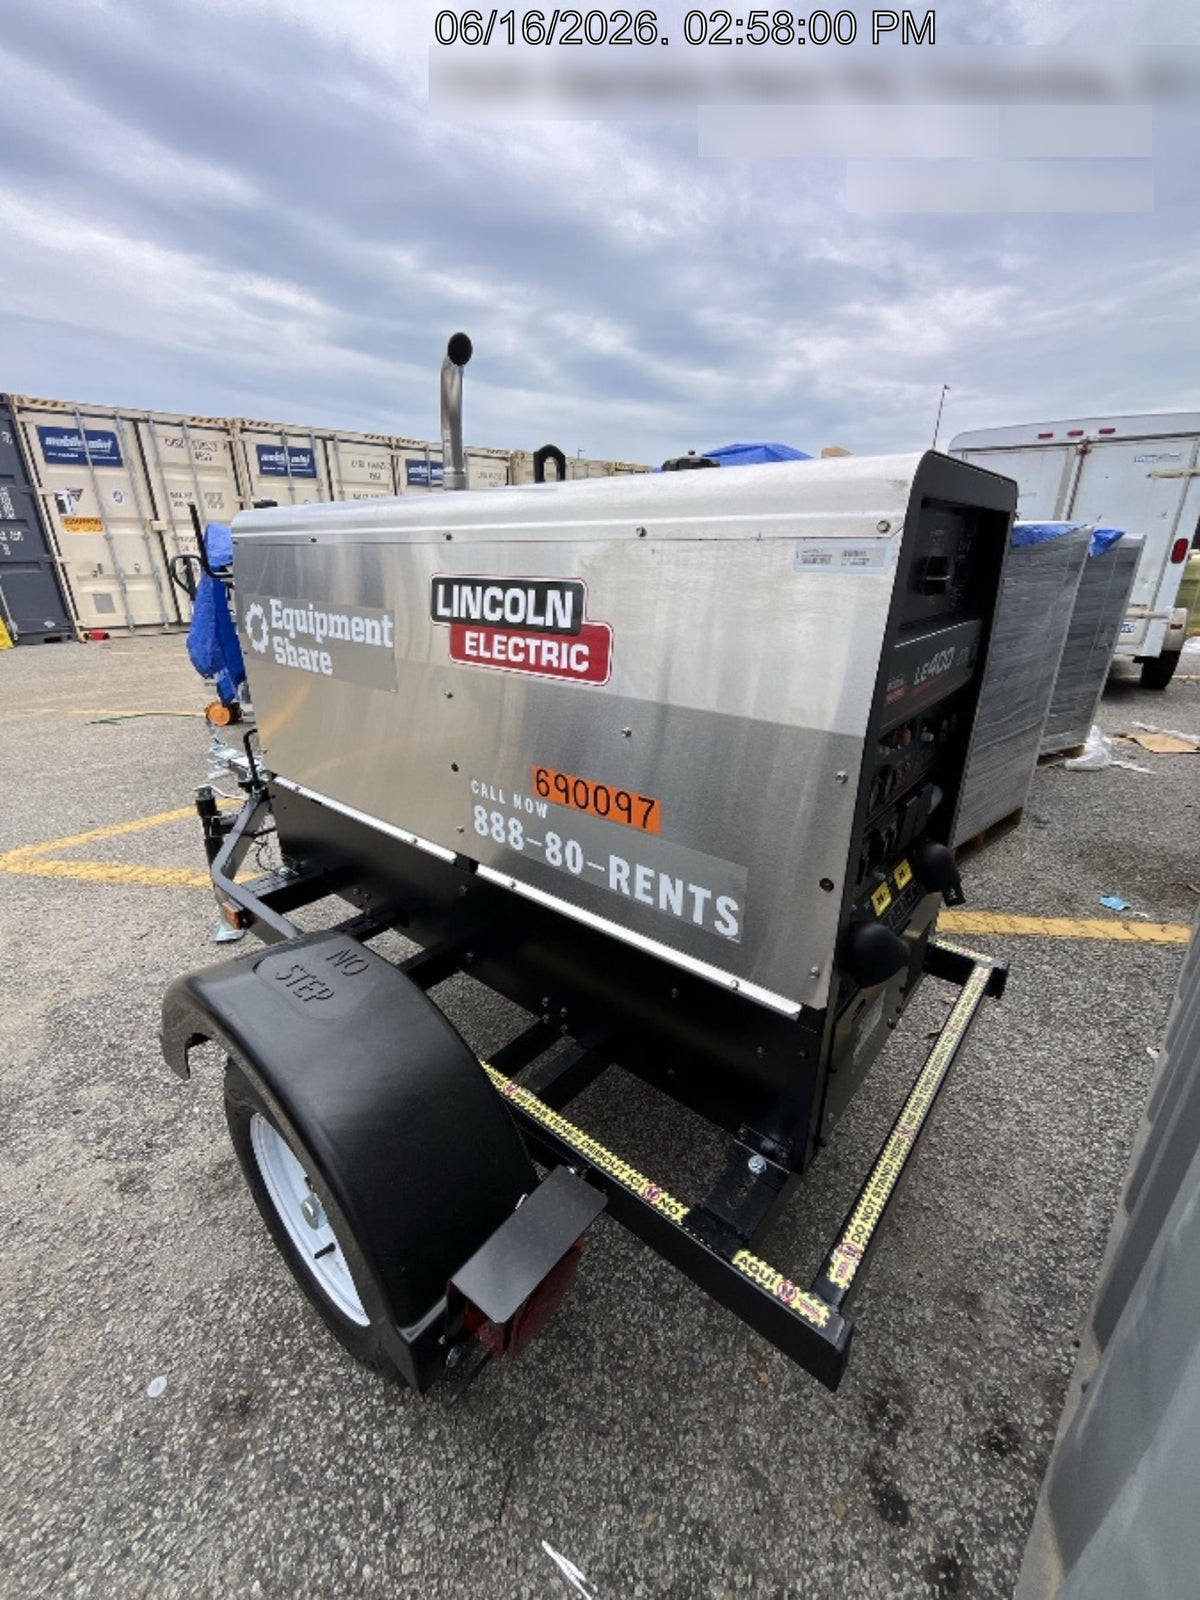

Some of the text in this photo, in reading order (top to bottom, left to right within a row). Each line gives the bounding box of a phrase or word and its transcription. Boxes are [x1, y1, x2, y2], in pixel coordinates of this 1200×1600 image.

[270, 598, 394, 648] Equipment
[436, 584, 573, 628] LINCOLN
[272, 636, 334, 676] Share
[464, 630, 590, 673] ELECTRIC
[470, 779, 549, 819] CALL NOW
[536, 768, 655, 829] 690097
[473, 804, 740, 937] 888-80-RENTS
[274, 963, 335, 1002] STEP
[325, 948, 370, 977] NO
